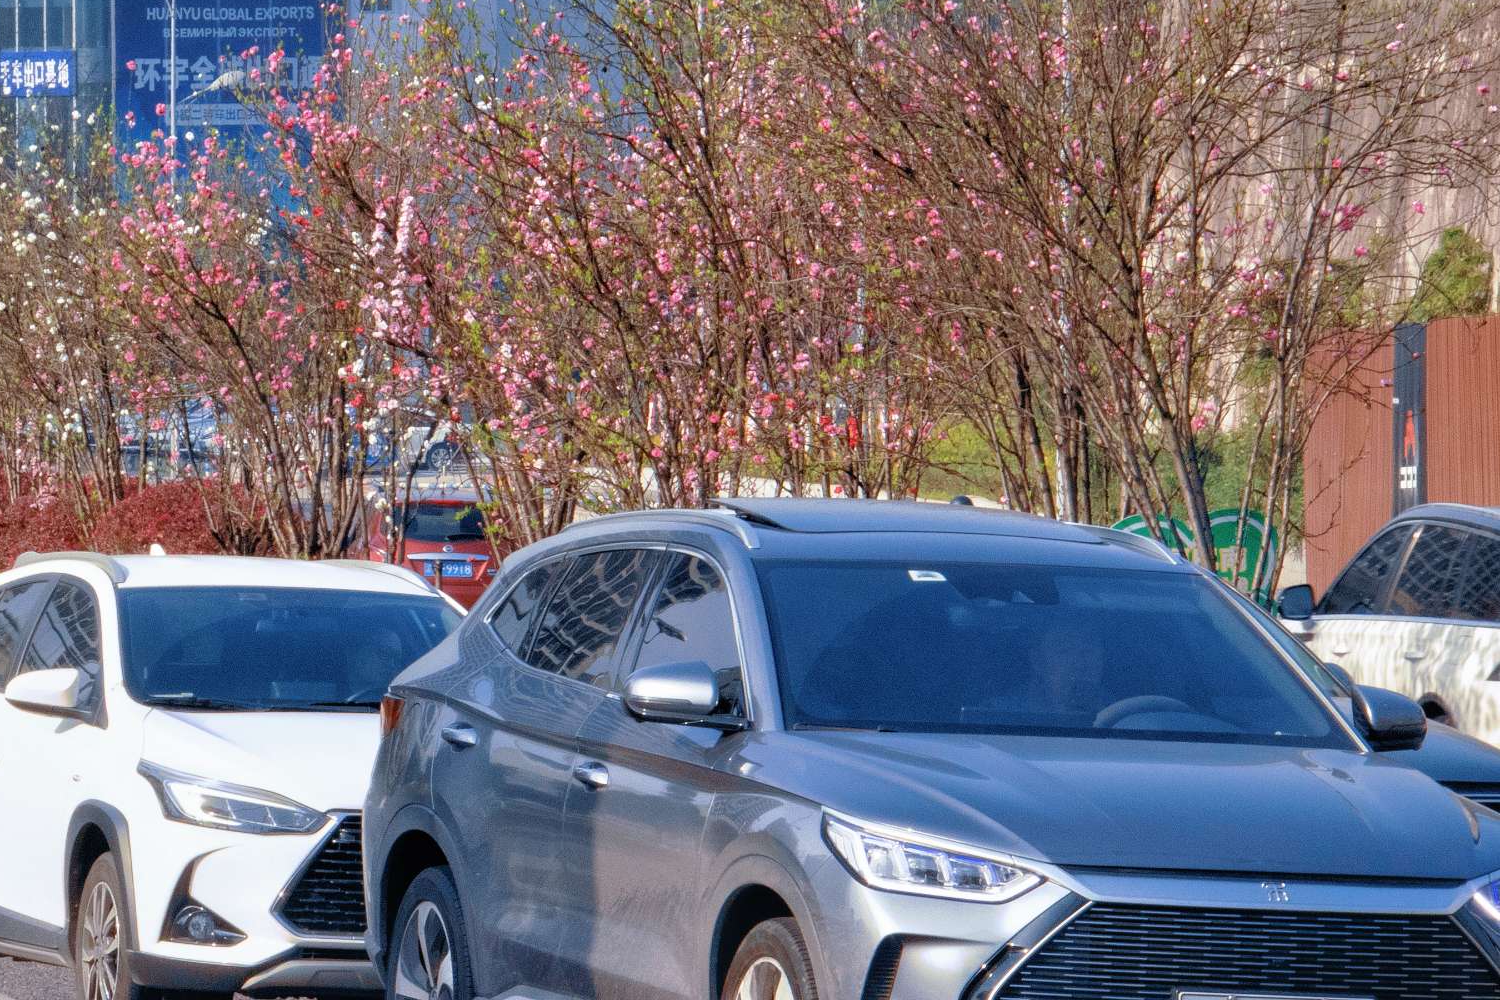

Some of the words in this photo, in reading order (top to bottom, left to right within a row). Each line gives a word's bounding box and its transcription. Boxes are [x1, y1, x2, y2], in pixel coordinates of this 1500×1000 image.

[146, 7, 200, 21] HUANYU
[202, 7, 252, 21] GLOBAL
[254, 6, 315, 21] EXPORTS
